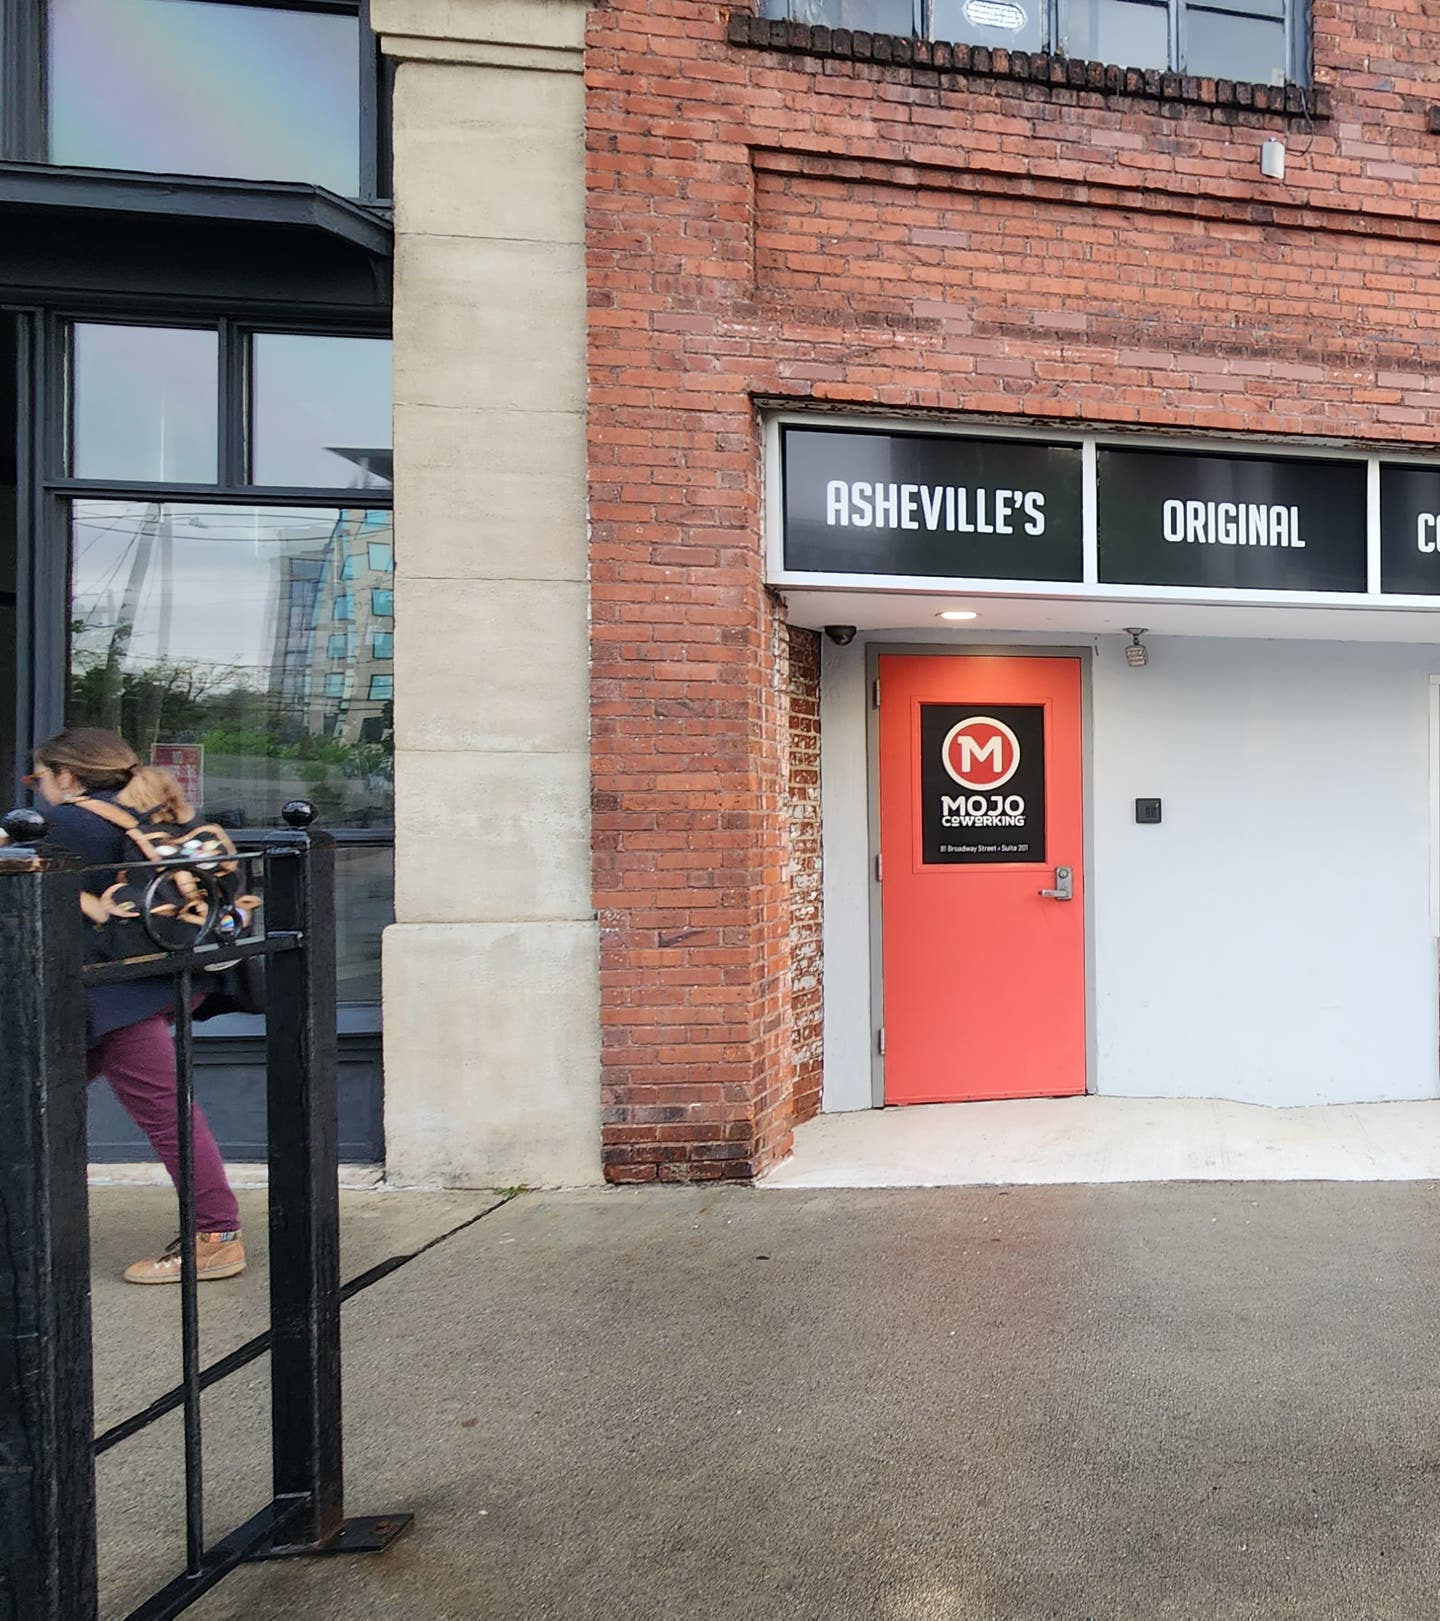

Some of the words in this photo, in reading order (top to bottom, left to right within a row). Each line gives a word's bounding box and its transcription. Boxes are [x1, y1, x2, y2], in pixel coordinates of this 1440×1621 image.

[826, 480, 1046, 537] ASHEVILLE'S
[1162, 499, 1306, 549] ORIGINAL
[957, 735, 1003, 773] M
[940, 795, 1025, 817] MOJO
[947, 845, 977, 854] Broadway
[978, 844, 997, 852] Street
[1001, 844, 1018, 852] Suite
